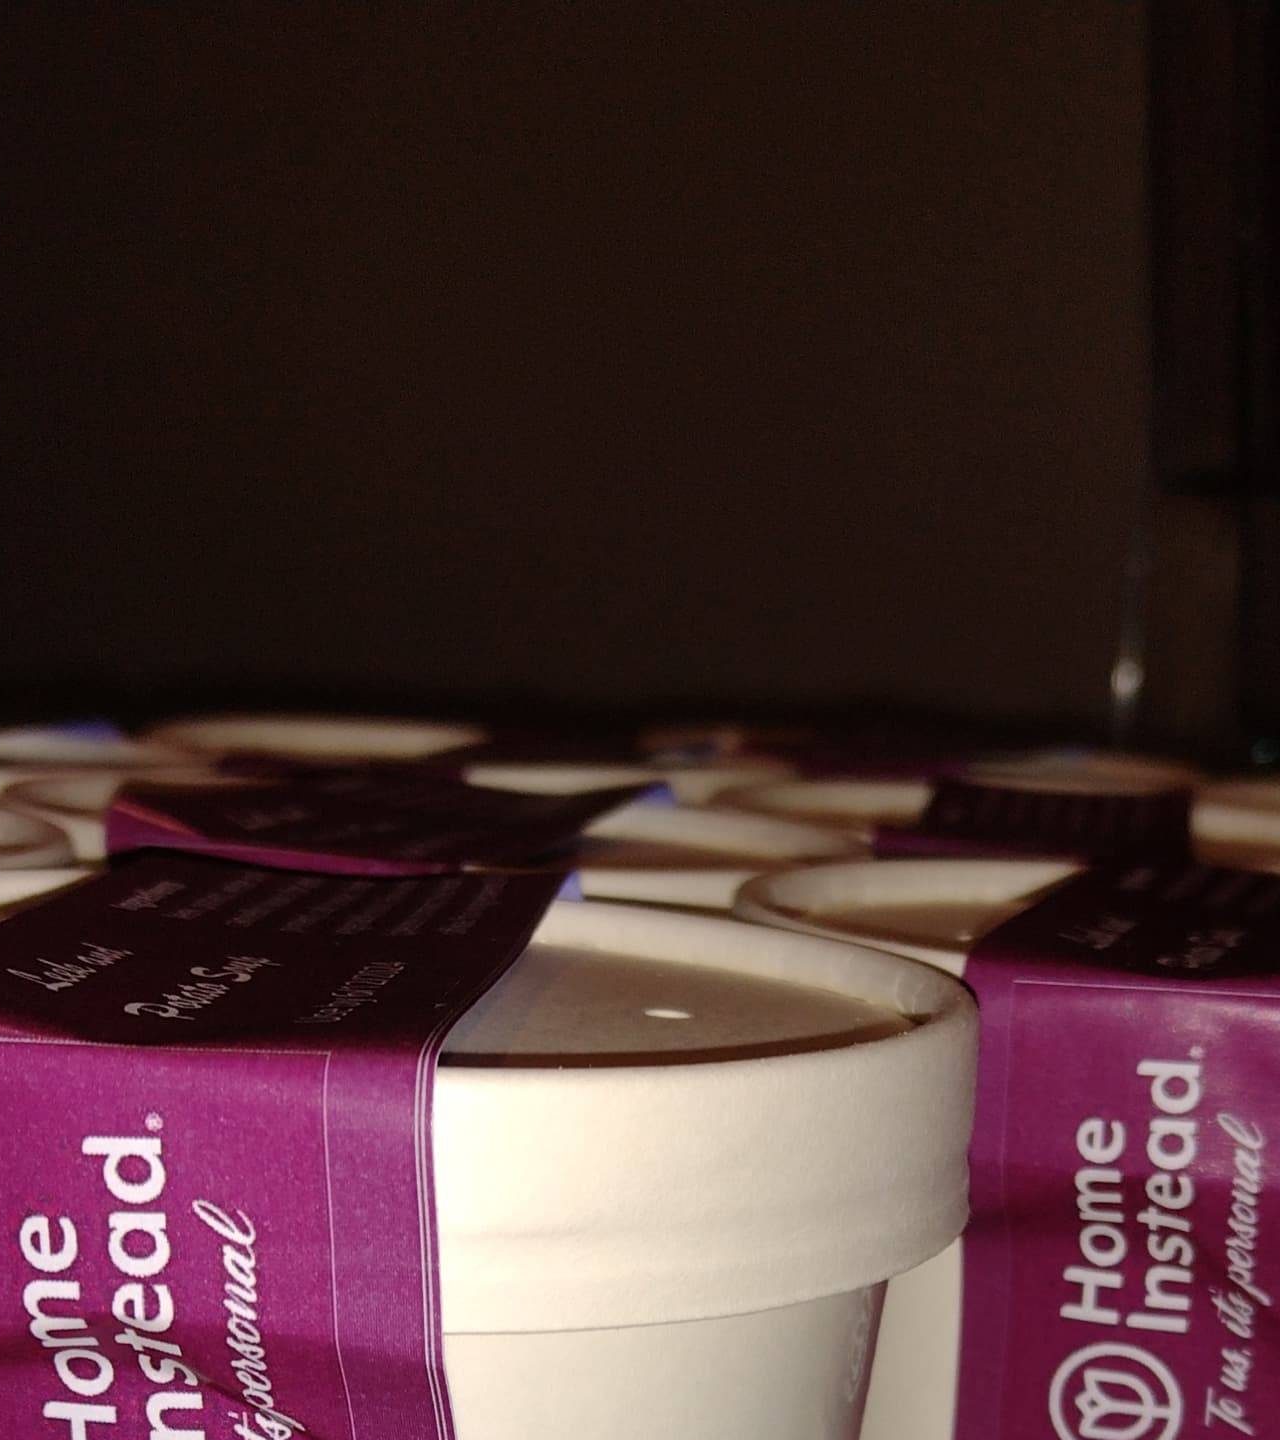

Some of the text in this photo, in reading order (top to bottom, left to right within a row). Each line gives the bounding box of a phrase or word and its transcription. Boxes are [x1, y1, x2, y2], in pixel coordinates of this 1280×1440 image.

[122, 954, 285, 1022] Potato Soup
[1059, 1116, 1128, 1326] Home
[1217, 1112, 1272, 1307] personal
[192, 1200, 306, 1431] personal
[1204, 1385, 1255, 1437] To
